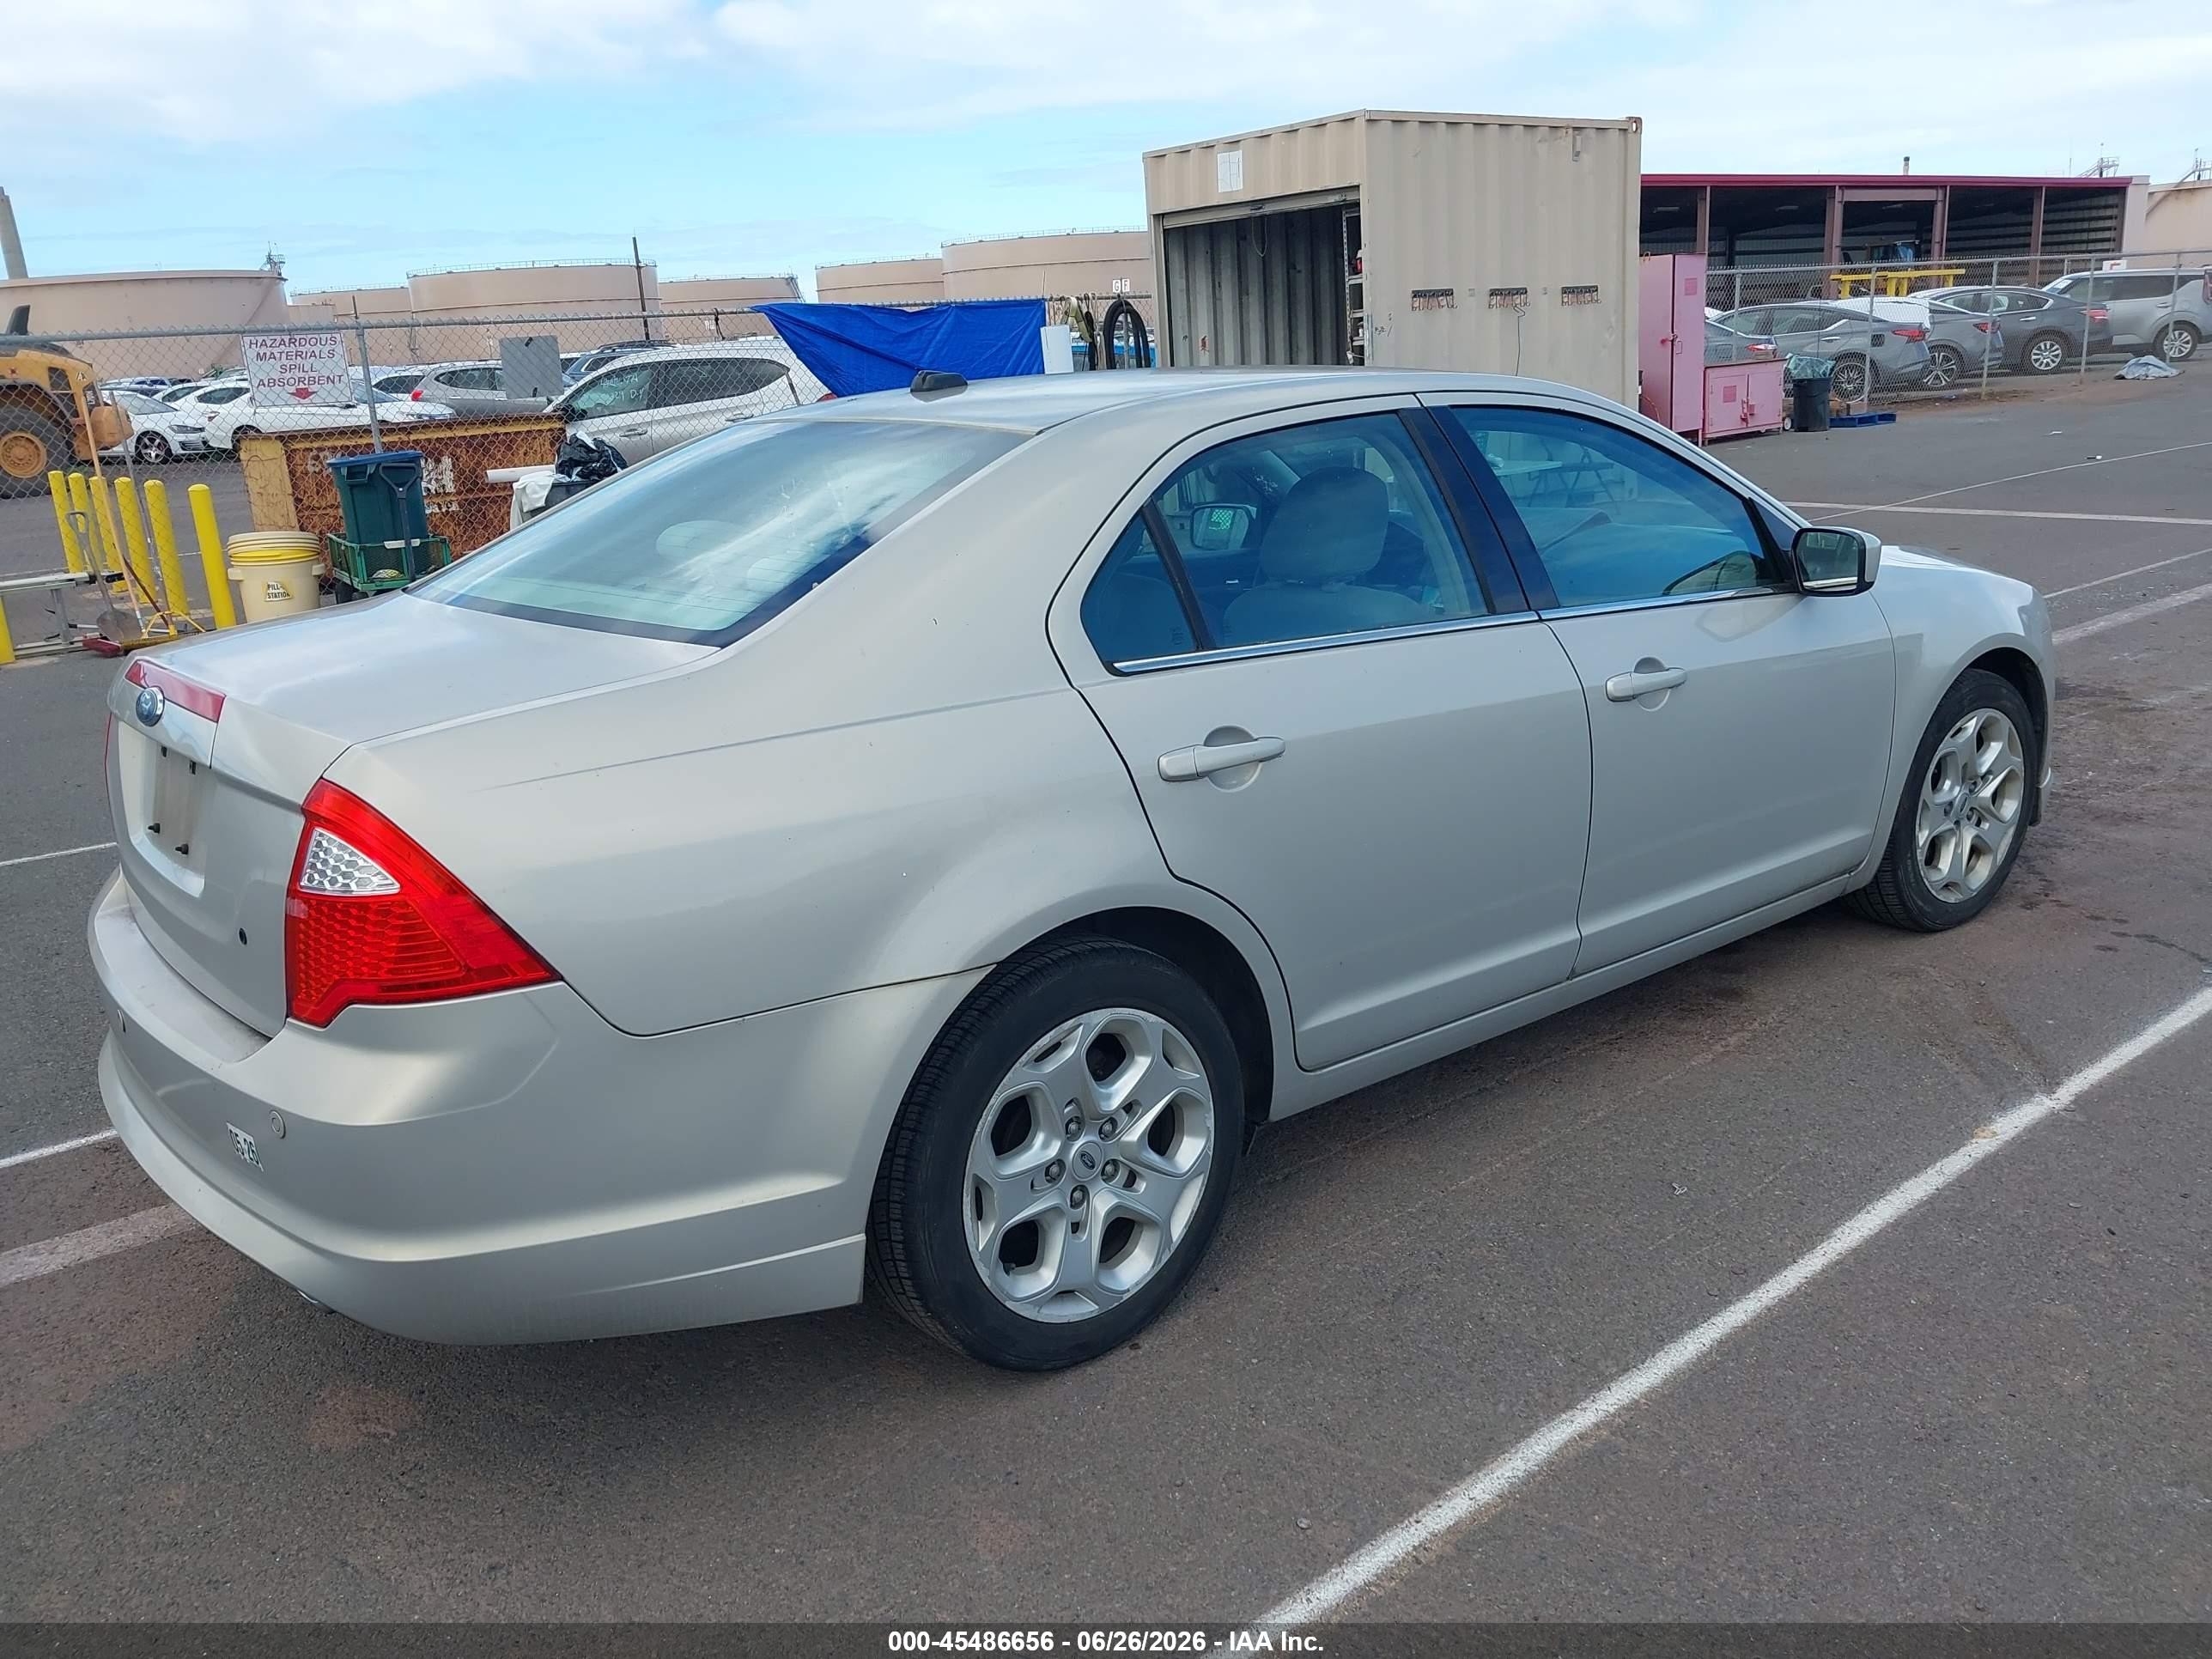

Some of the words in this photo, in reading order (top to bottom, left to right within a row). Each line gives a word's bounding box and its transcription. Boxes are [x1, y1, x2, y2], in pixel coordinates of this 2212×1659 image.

[249, 336, 337, 349] HAZARDOUS
[256, 349, 336, 362] MATERIALS
[279, 362, 318, 374] SPILL
[257, 374, 343, 388] ABSORBENT
[228, 1128, 245, 1156] 05
[243, 1138, 261, 1165] 26
